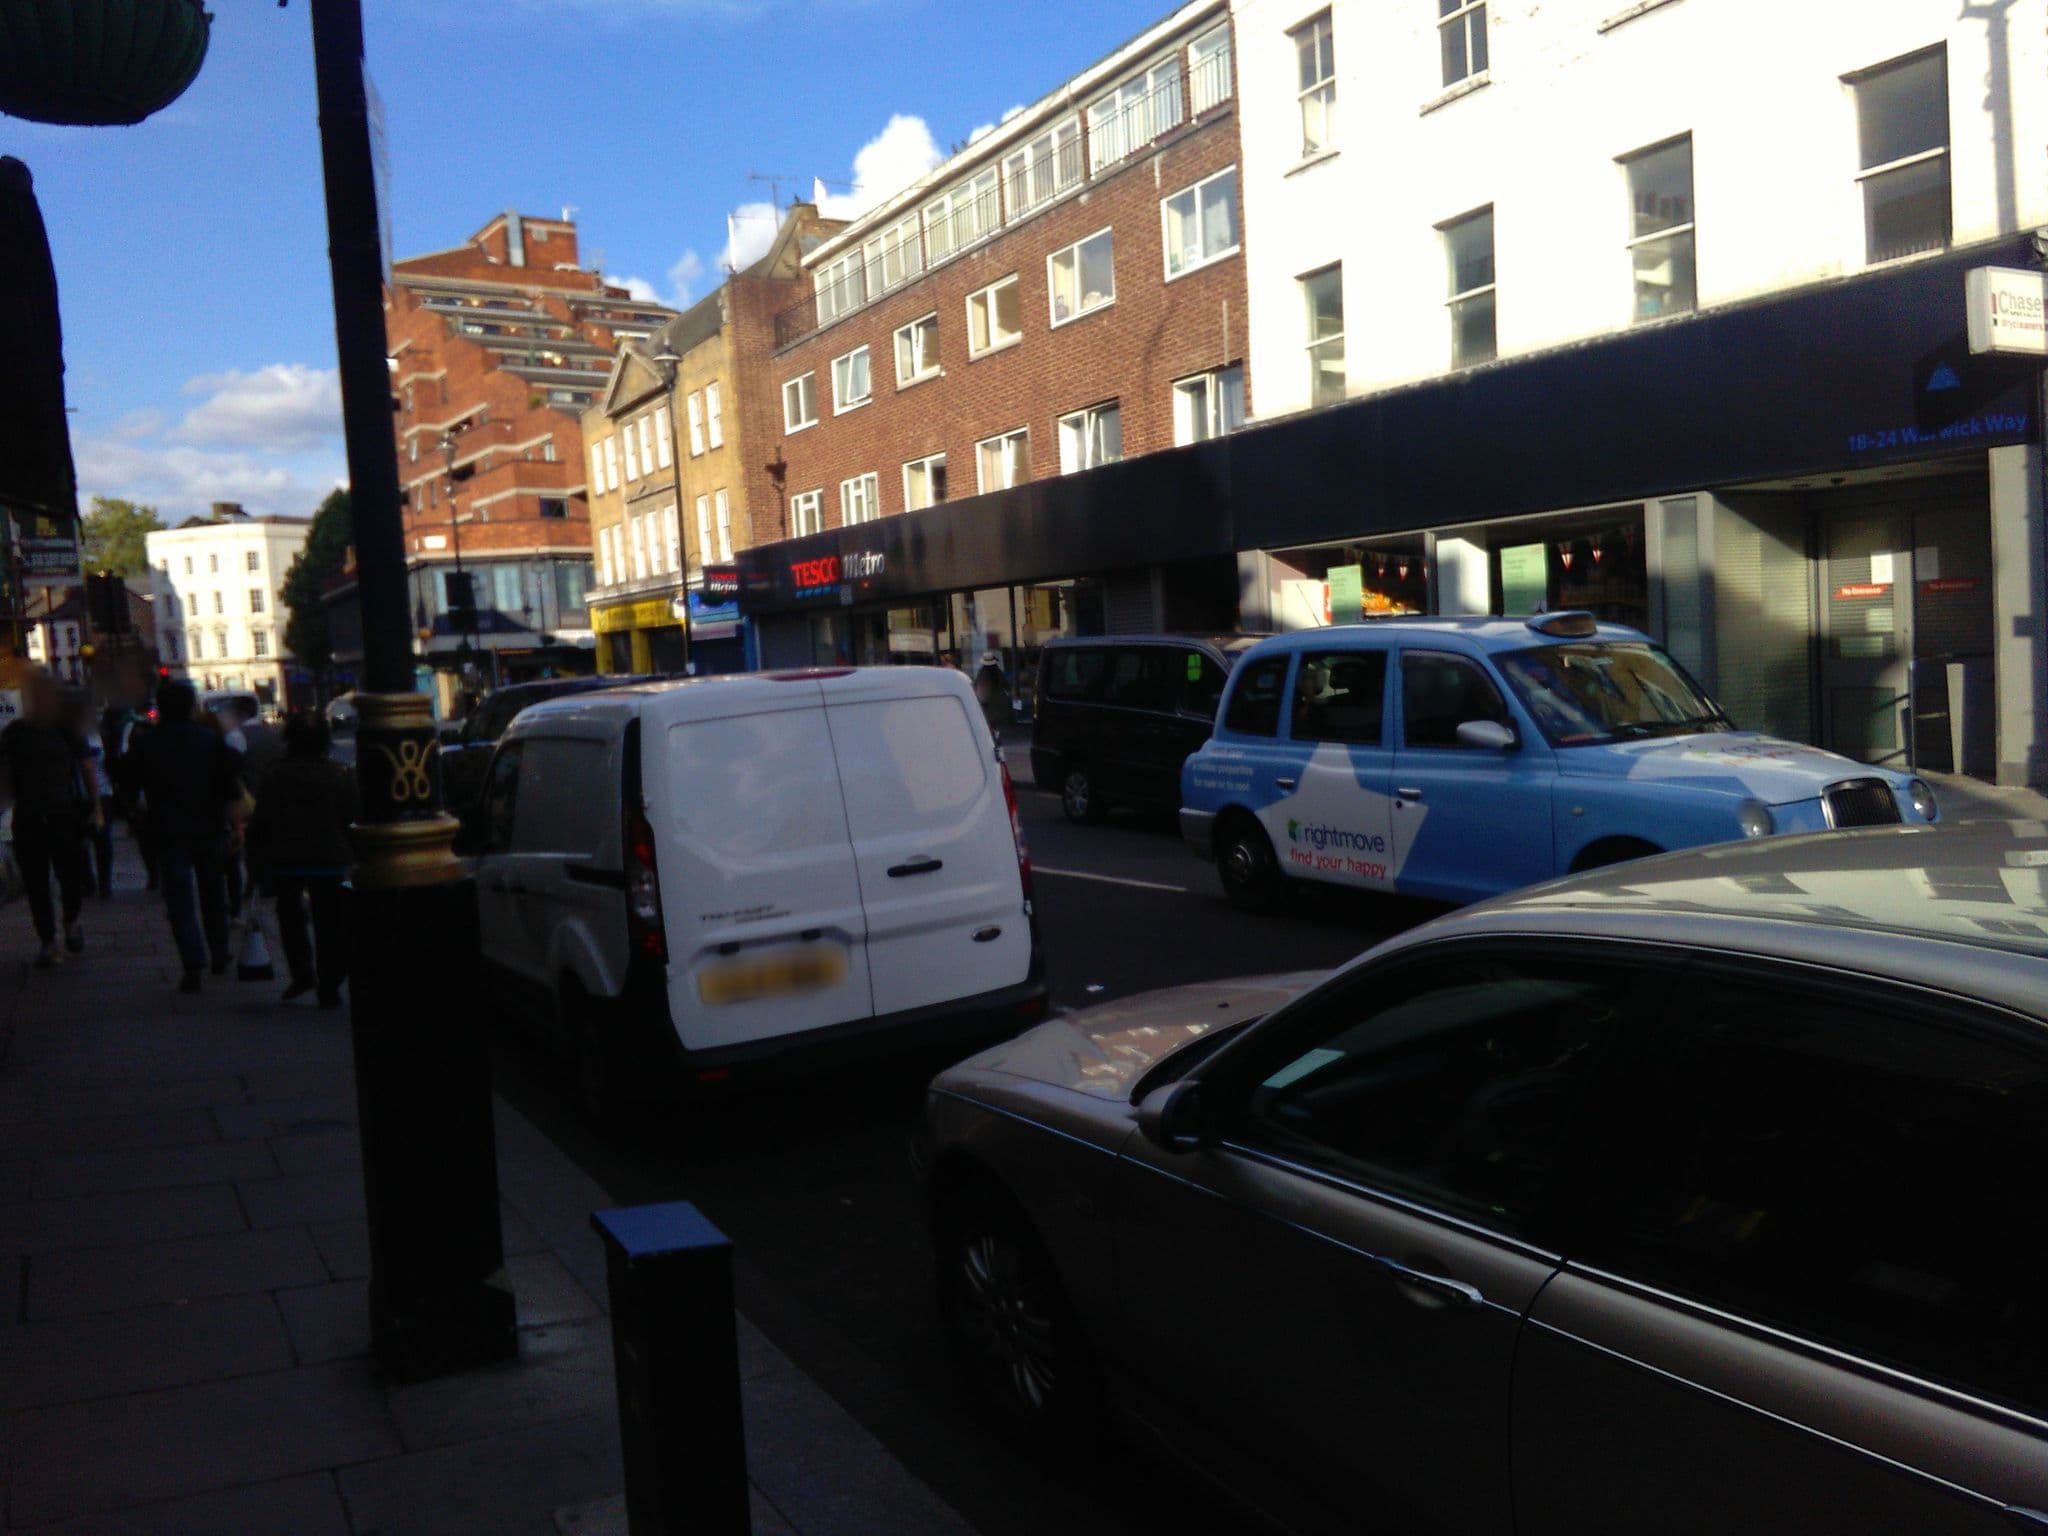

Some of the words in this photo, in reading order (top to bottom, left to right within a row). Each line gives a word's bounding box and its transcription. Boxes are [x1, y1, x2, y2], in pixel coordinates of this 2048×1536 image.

[1999, 290, 2042, 313] Chase
[1847, 431, 1898, 456] 18-24
[1902, 416, 1980, 444] Wwick
[1985, 412, 2028, 433] Way
[790, 555, 840, 588] TESCO
[842, 550, 885, 580] Metro
[1304, 823, 1385, 852] rightmove
[1290, 847, 1312, 865] find
[1316, 855, 1343, 871] your
[1346, 856, 1386, 881] happy
